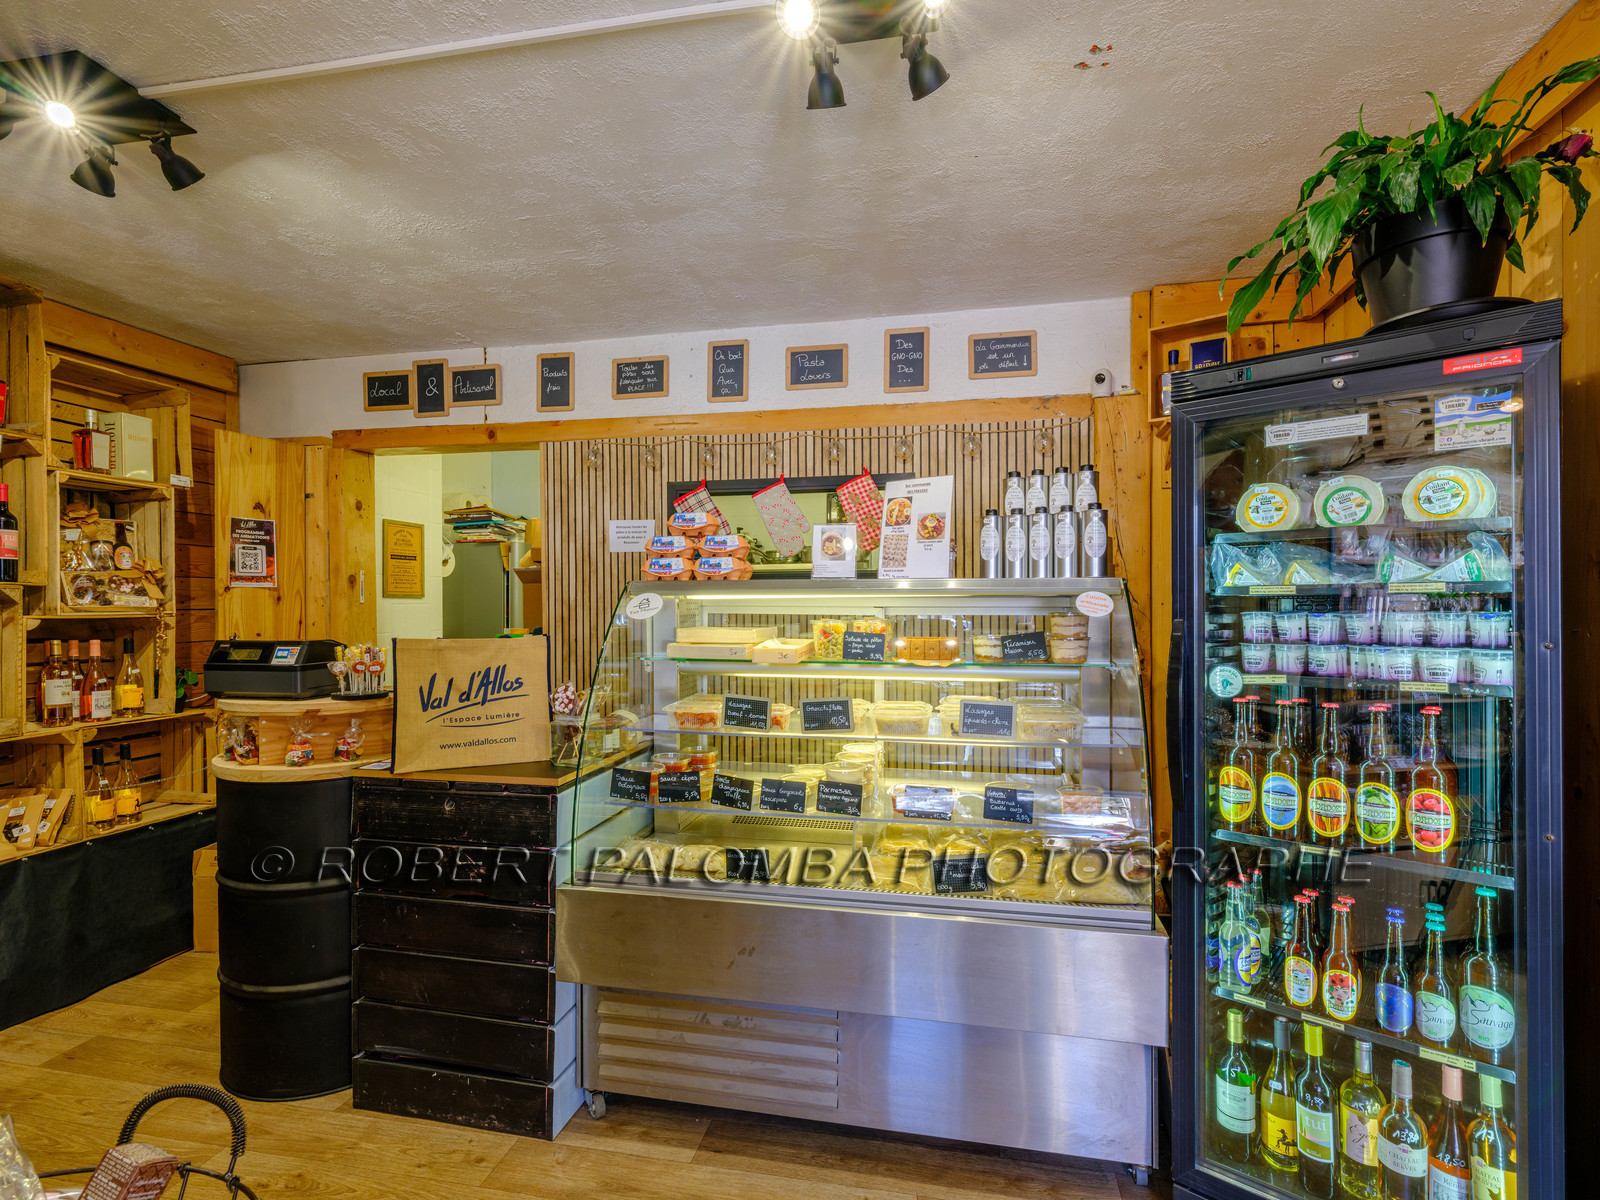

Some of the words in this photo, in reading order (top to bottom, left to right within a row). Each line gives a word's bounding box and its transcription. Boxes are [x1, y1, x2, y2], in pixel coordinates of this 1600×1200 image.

[895, 339, 913, 350] Des
[795, 354, 825, 367] Pasta
[891, 351, 923, 361] GNO-GNO
[800, 368, 831, 382] Lovers
[896, 364, 914, 373] Des
[370, 381, 402, 398] Local
[425, 377, 439, 397] &
[454, 376, 494, 394] Artisanal
[419, 673, 454, 712] Val
[459, 664, 524, 706] d'Allos
[443, 713, 482, 724] l'Espace
[485, 711, 520, 721] Lumière
[439, 735, 517, 750] www.valdallos.com
[819, 784, 852, 796] Parmesan
[1422, 1011, 1455, 1027] Sauvage
[1471, 1010, 1514, 1031] Sauvage
[1478, 1035, 1490, 1043] BIO
[1305, 1115, 1327, 1132] tui
[1388, 1150, 1421, 1165] CHATEAU
